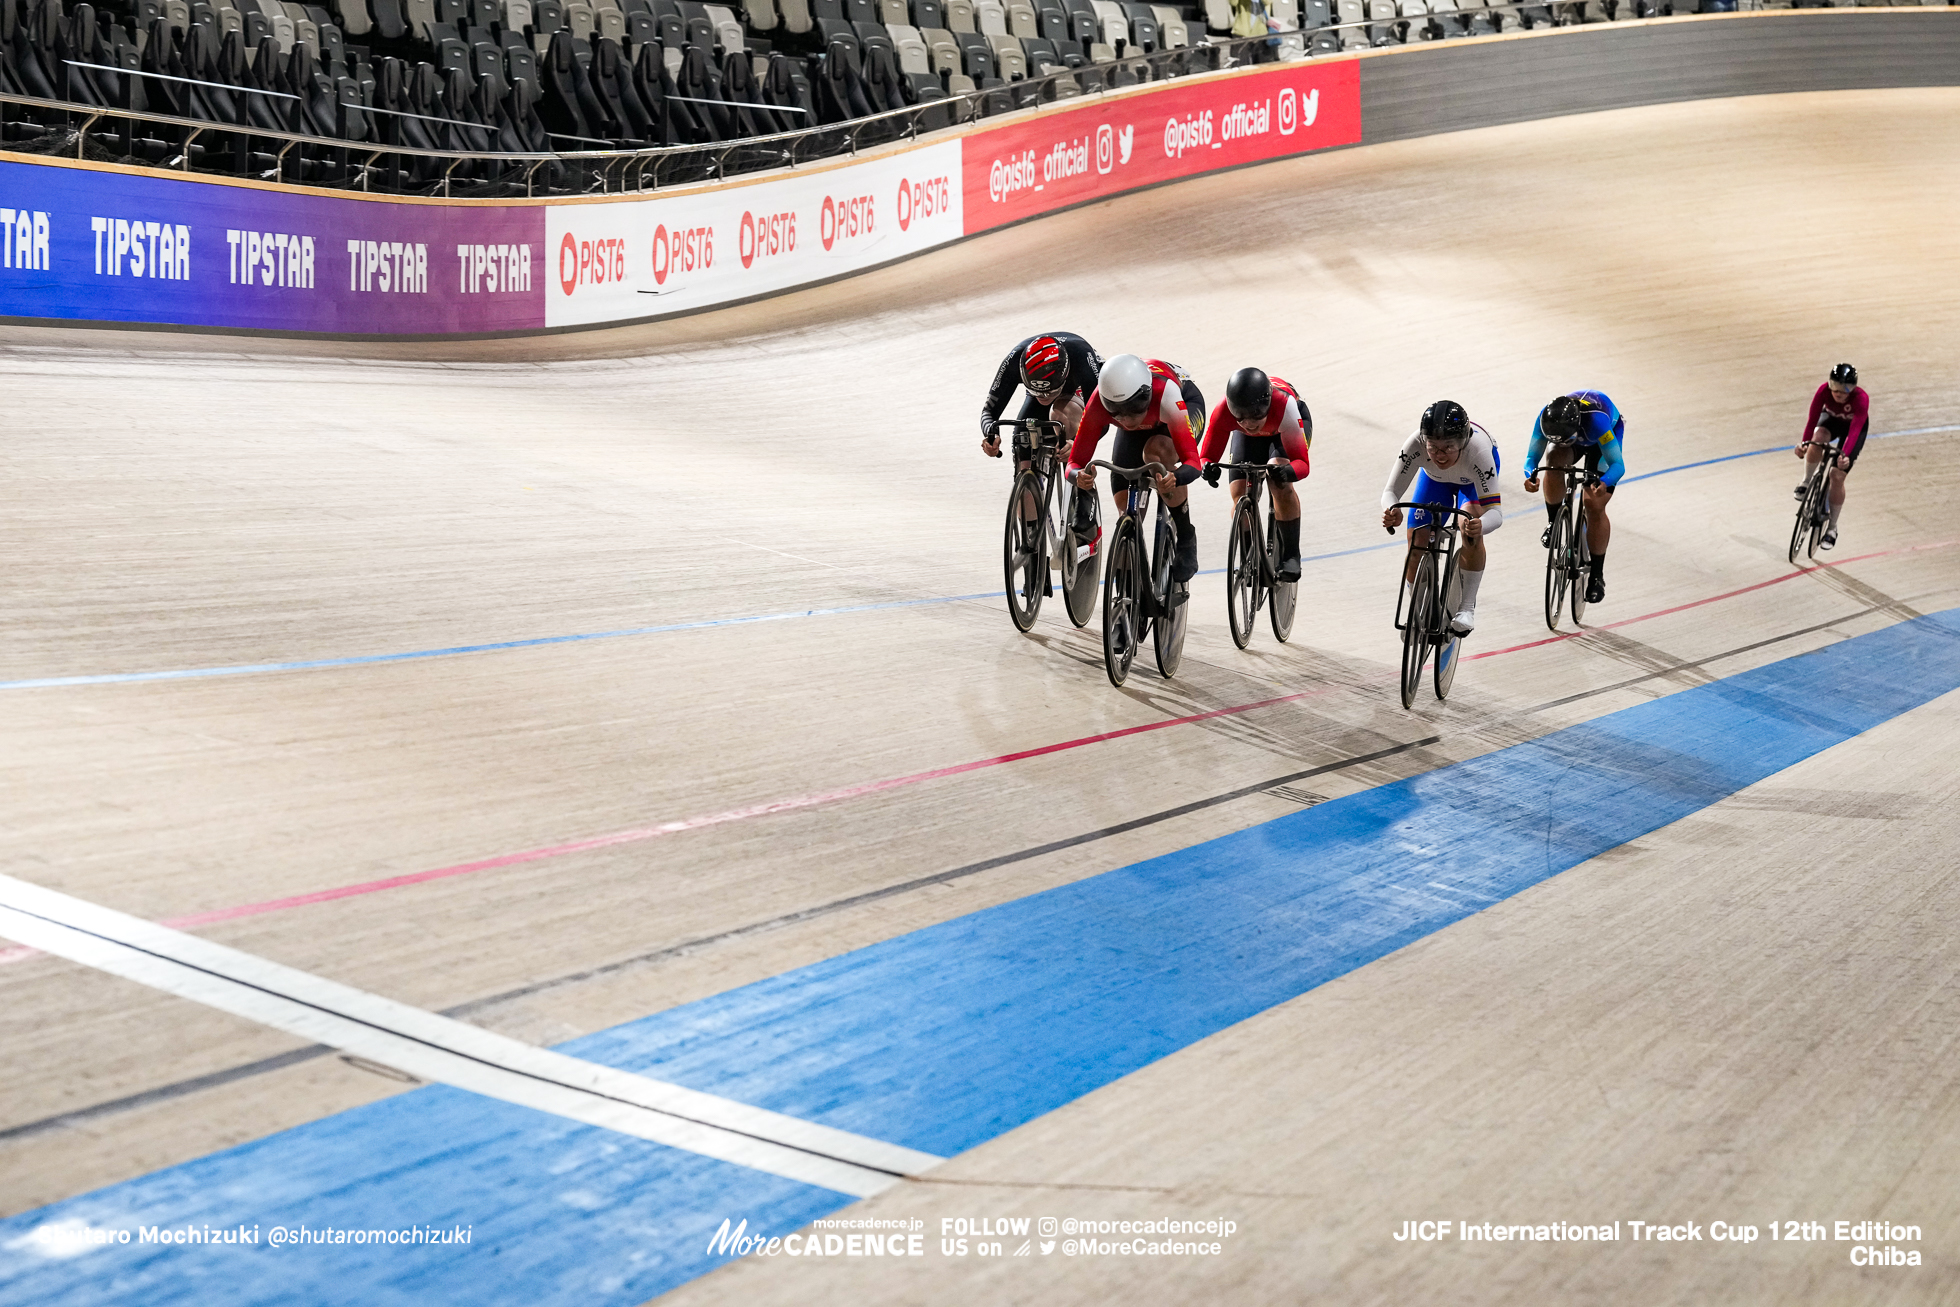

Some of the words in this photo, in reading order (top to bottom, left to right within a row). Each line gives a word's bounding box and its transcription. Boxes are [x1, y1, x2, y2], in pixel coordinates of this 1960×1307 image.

[1164, 99, 1270, 159] @pist6_official
[989, 137, 1088, 203] @pist6_official
[837, 195, 874, 240] PIST6
[912, 176, 949, 220] PIST6
[91, 216, 190, 281] TIPSTAR
[227, 229, 315, 289] TIPSTAR
[672, 227, 713, 273] PIST6
[757, 212, 796, 258] PIST6
[347, 239, 427, 293] TIPSTAR
[457, 244, 531, 293] TIPSTAR
[580, 238, 624, 285] PIST6
